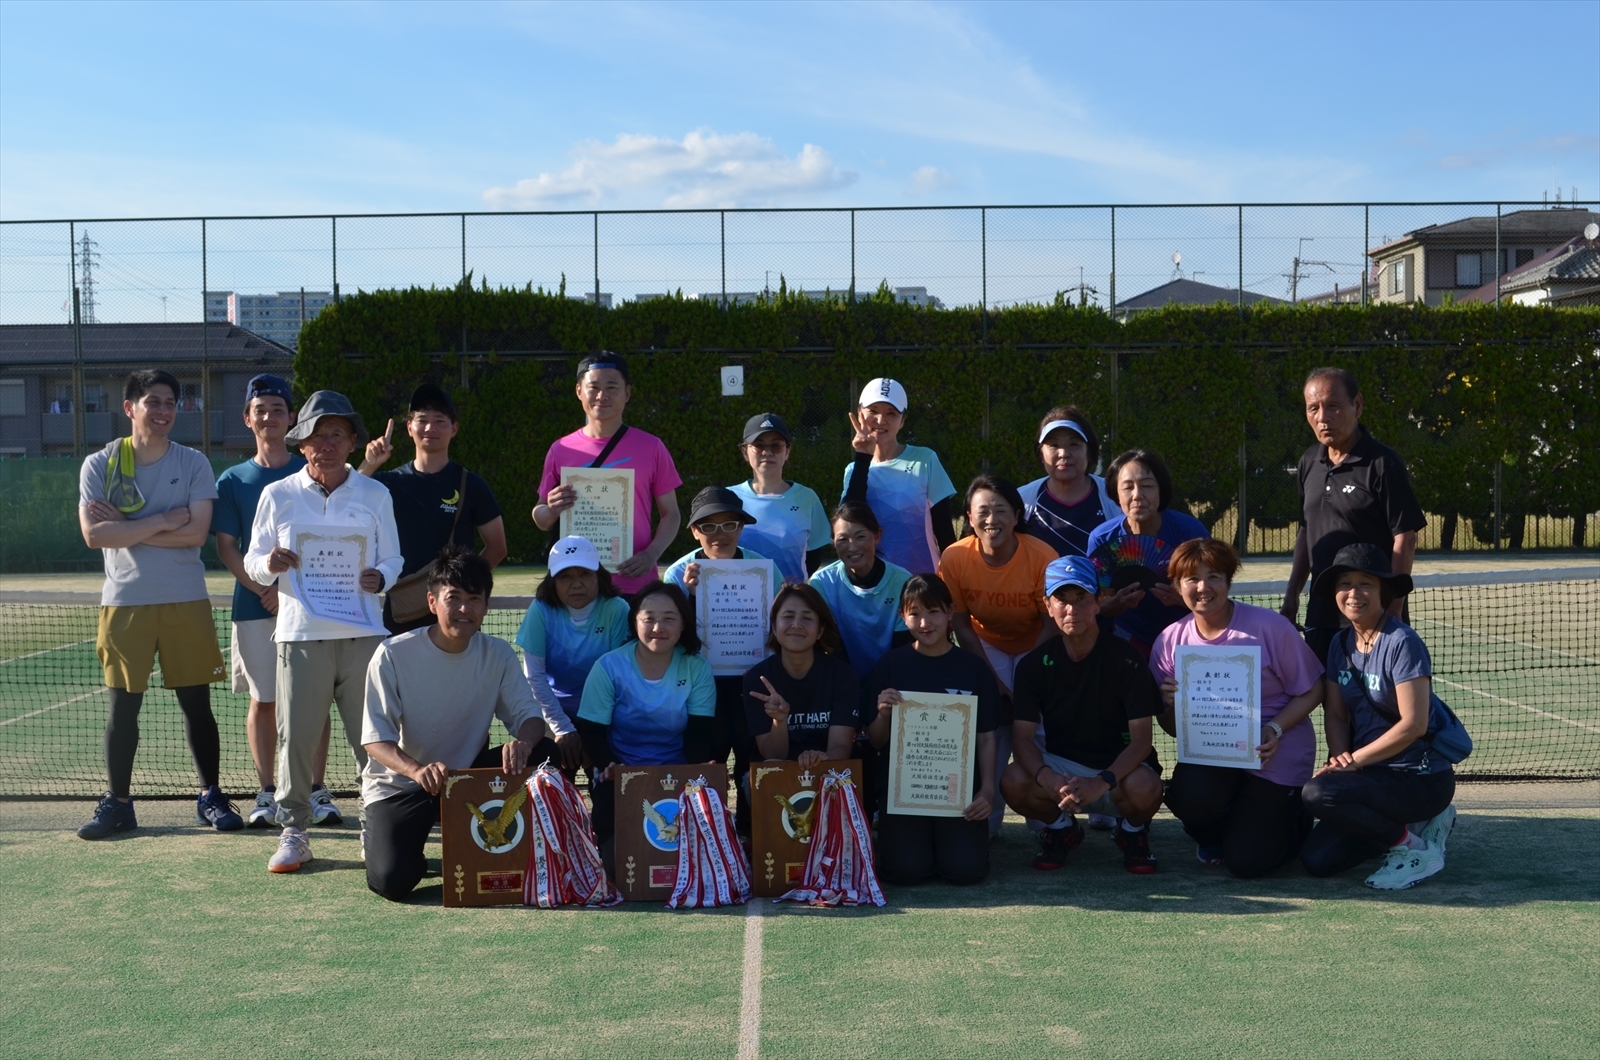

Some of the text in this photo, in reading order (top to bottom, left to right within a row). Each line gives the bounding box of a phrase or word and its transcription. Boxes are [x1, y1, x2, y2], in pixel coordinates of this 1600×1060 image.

[986, 591, 1038, 608] YONEX
[794, 713, 805, 724] IT
[920, 712, 947, 722] 賞状
